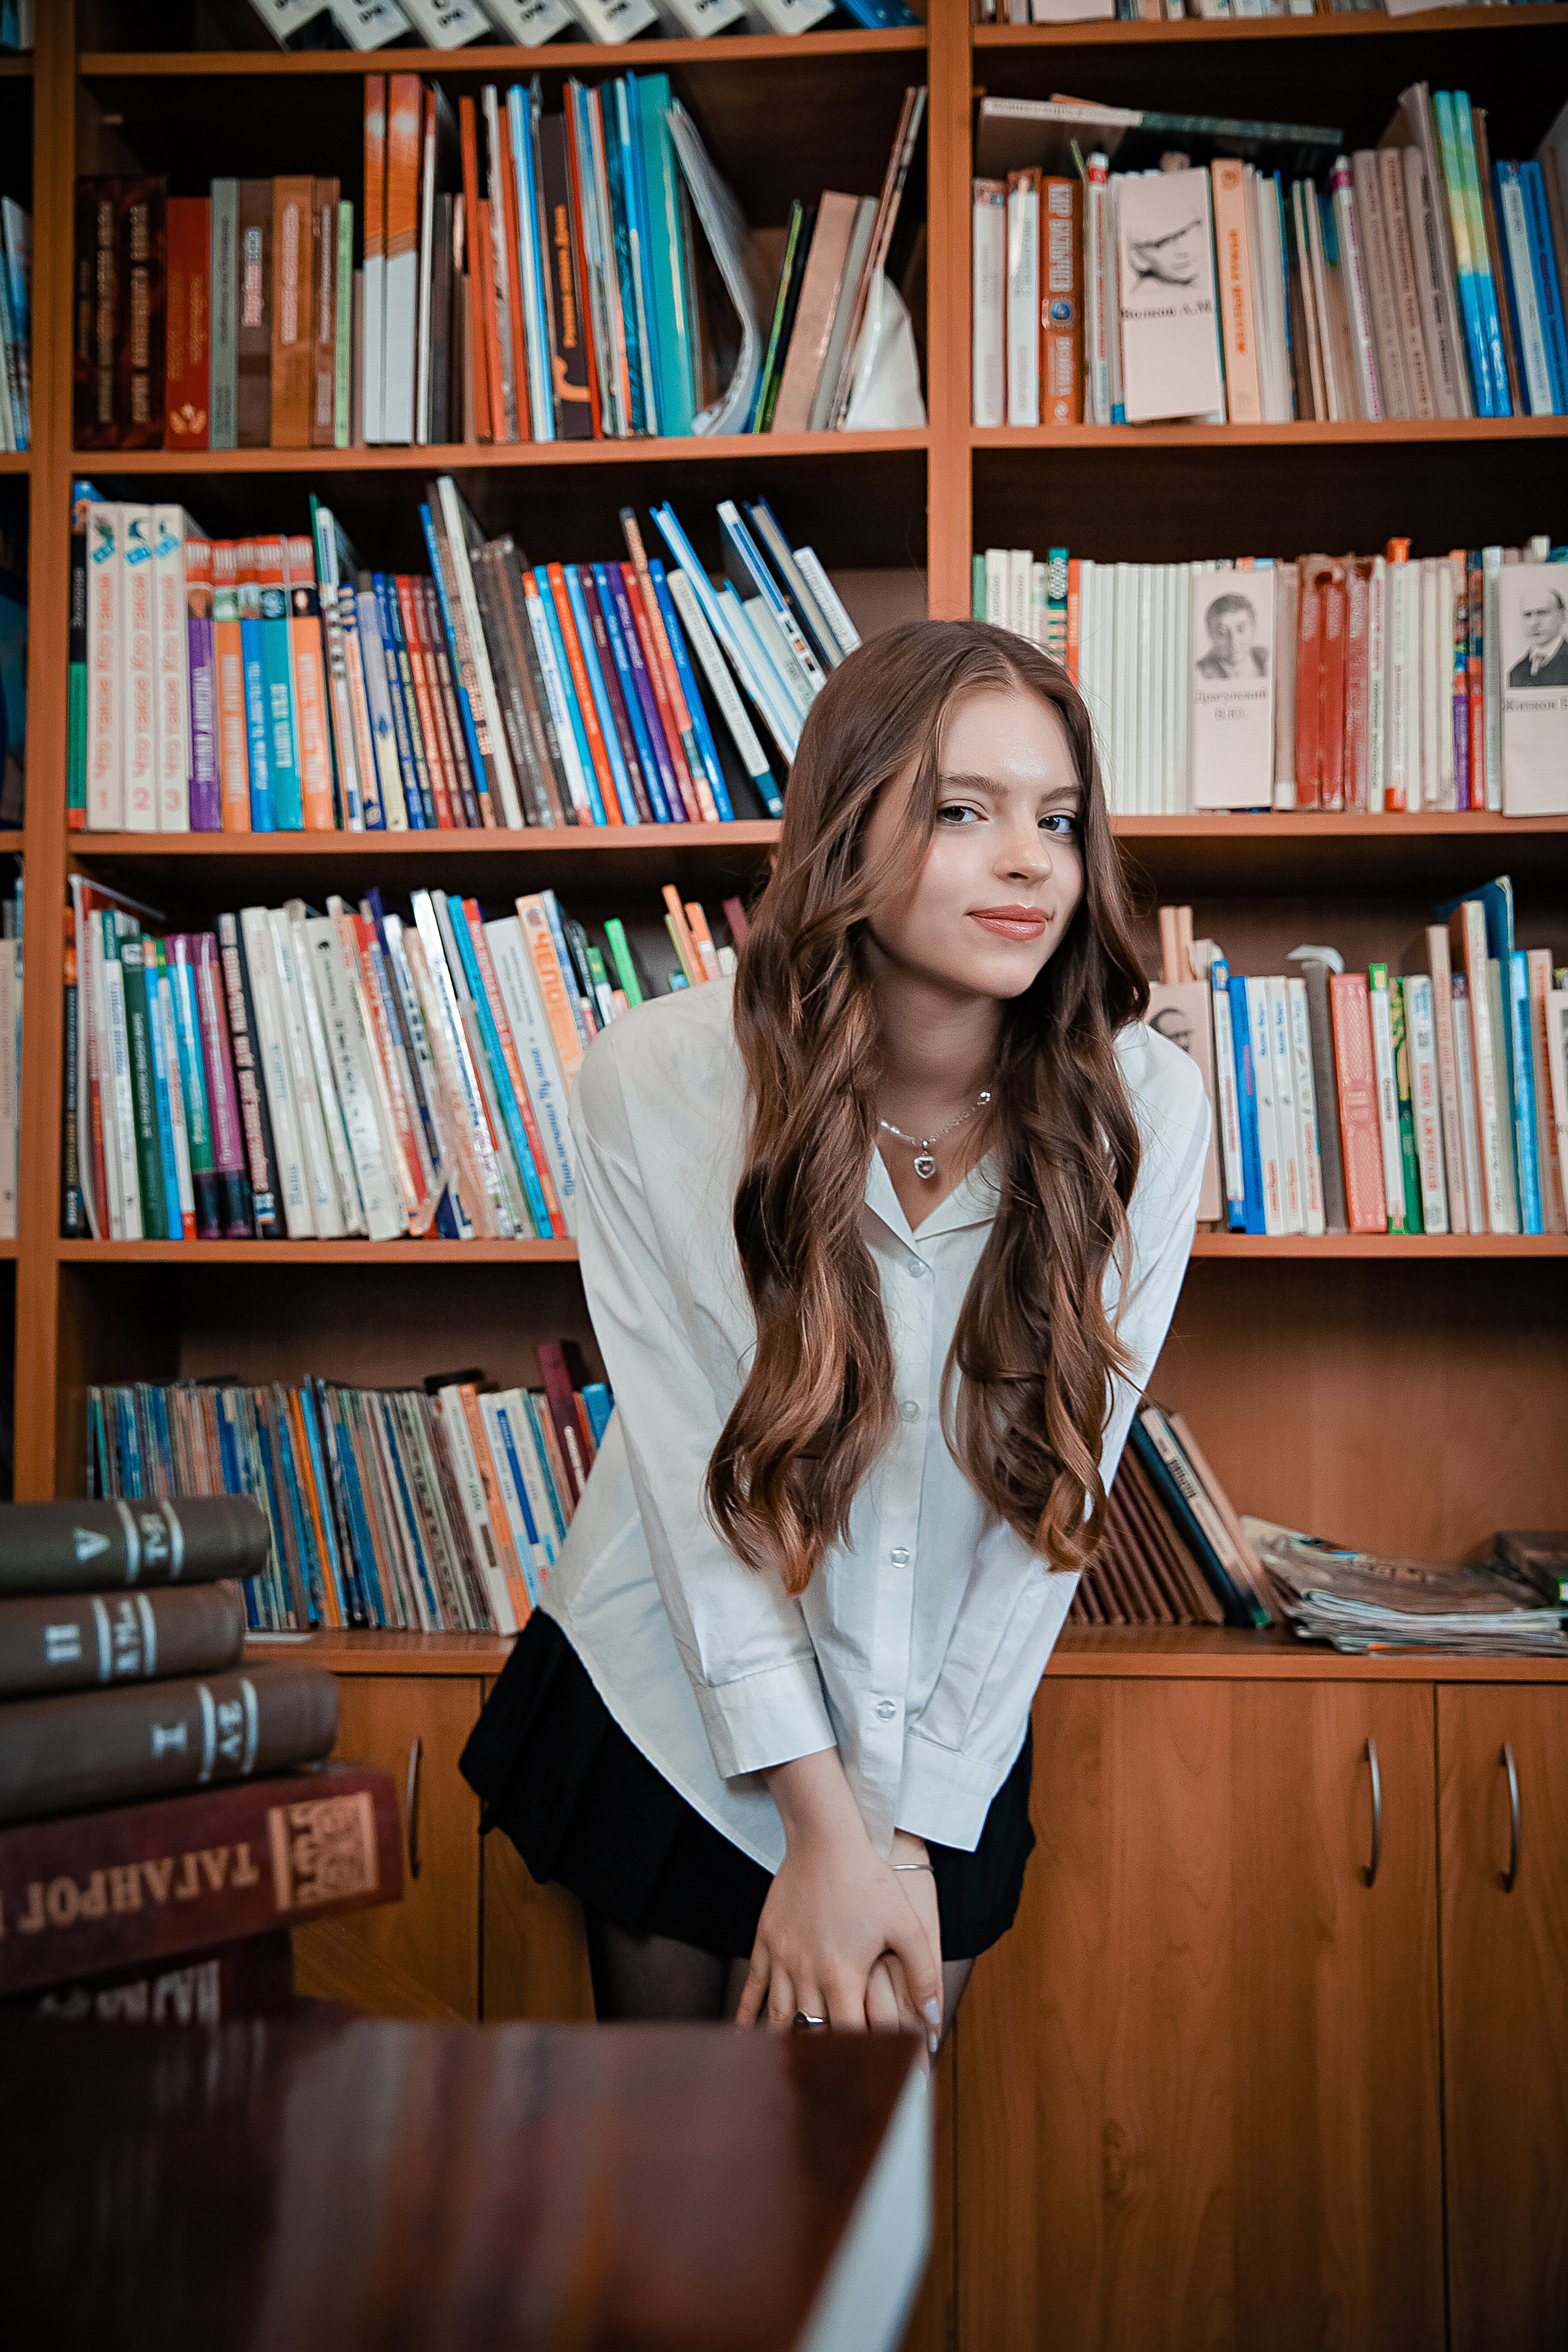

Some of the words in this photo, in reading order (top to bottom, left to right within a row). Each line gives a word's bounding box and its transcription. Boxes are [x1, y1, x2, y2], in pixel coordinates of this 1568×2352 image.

[99, 790, 109, 810] 1
[134, 788, 149, 810] 2
[165, 788, 181, 812] 3
[151, 1721, 187, 1757] I
[17, 1841, 262, 1936] ТАГАНРОГ
